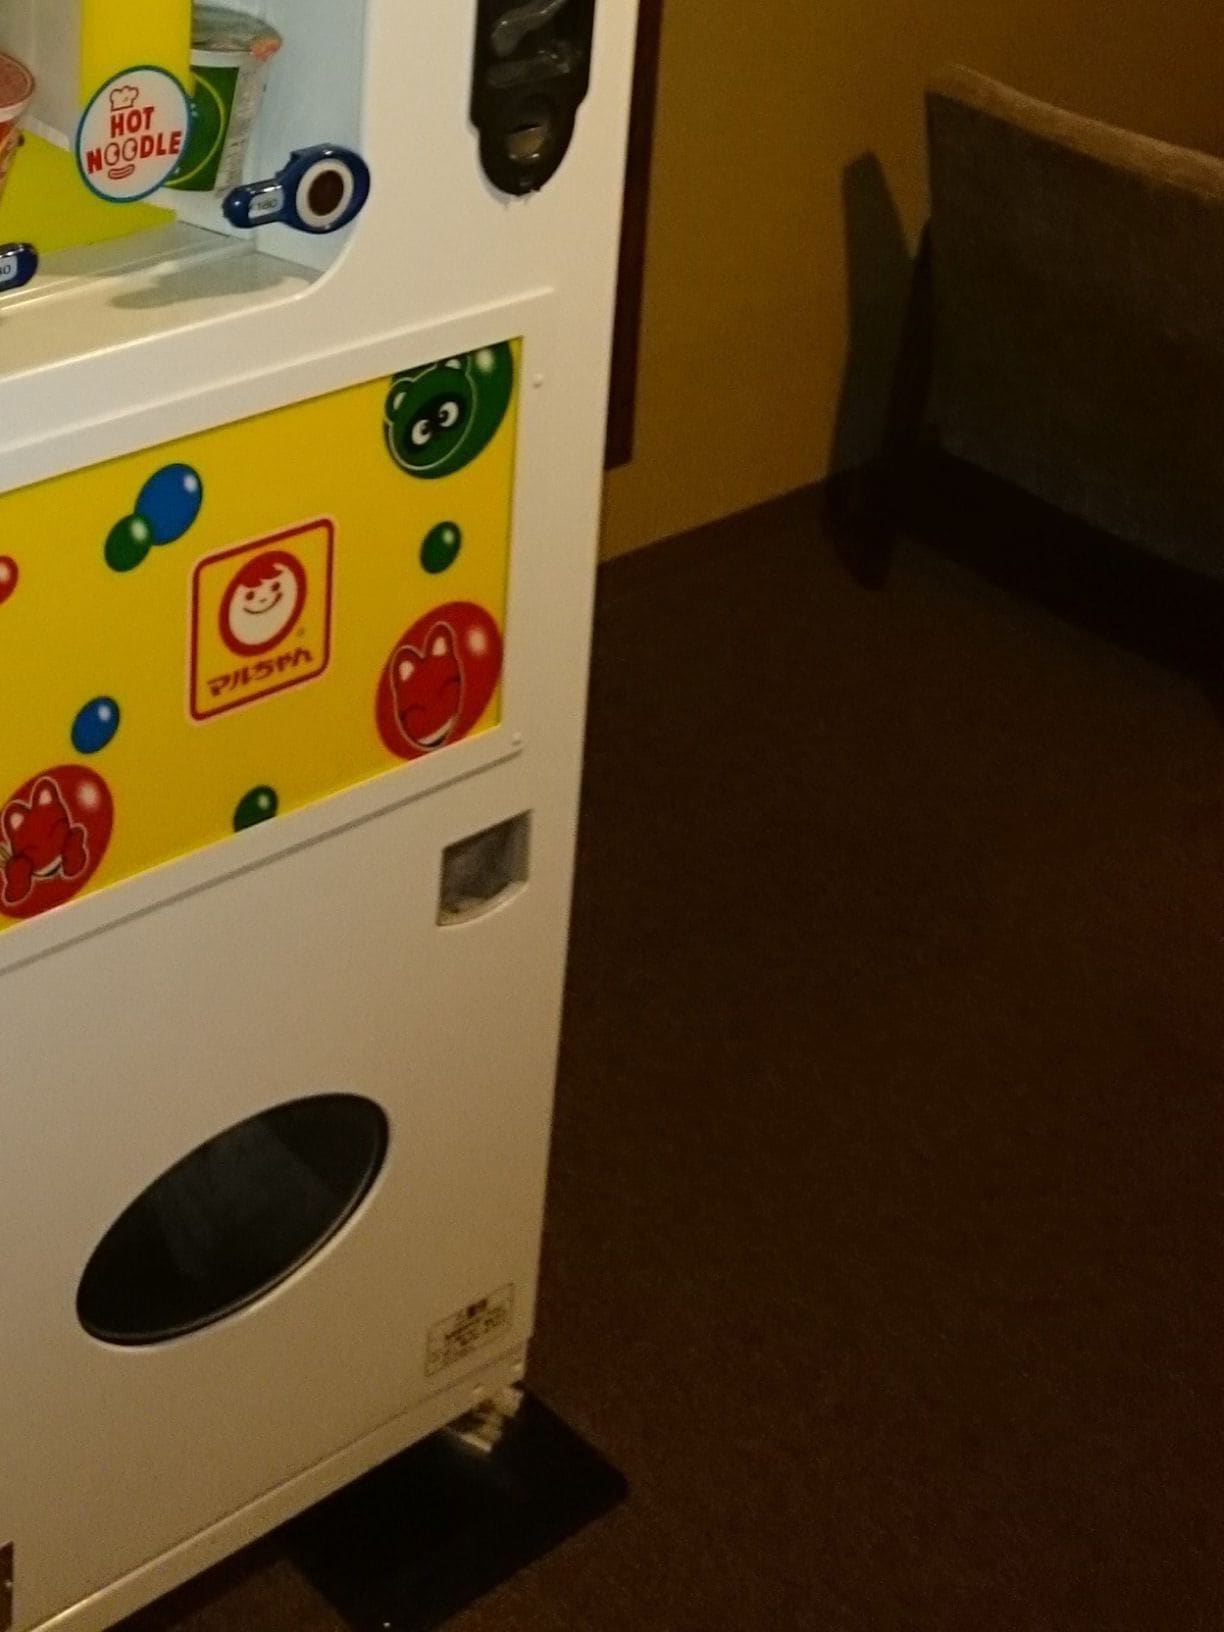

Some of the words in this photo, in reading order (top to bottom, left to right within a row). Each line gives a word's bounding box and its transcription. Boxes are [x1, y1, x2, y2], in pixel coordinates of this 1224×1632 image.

[110, 106, 155, 138] HOT
[86, 131, 182, 174] NOODLE
[207, 648, 313, 697] マルちゃん
